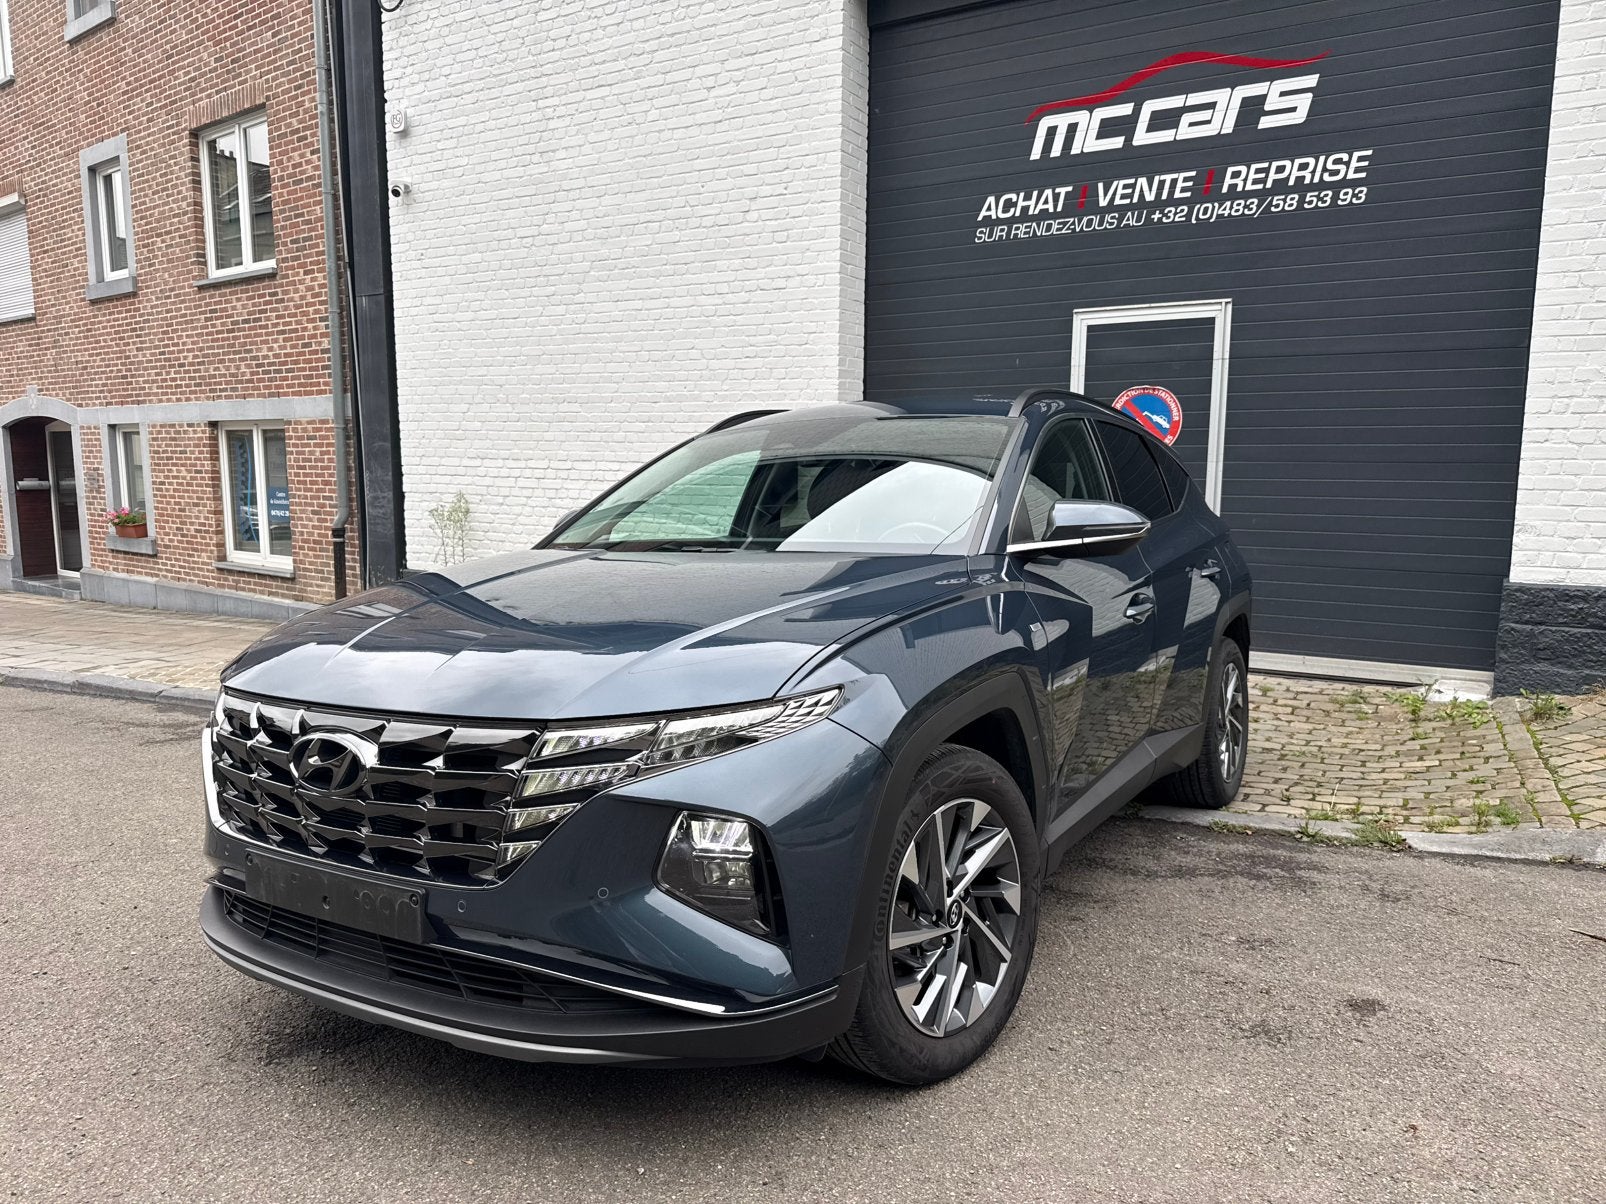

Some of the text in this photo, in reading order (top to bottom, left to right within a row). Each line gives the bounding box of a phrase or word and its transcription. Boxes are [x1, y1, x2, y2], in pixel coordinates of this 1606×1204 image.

[976, 149, 1373, 222] ACHAT VENTE REPRISE
[974, 186, 1368, 243] SUR RENDEZ-VOUS AU +32 (0)483/58 53 93
[1153, 388, 1180, 421] STATIONNER
